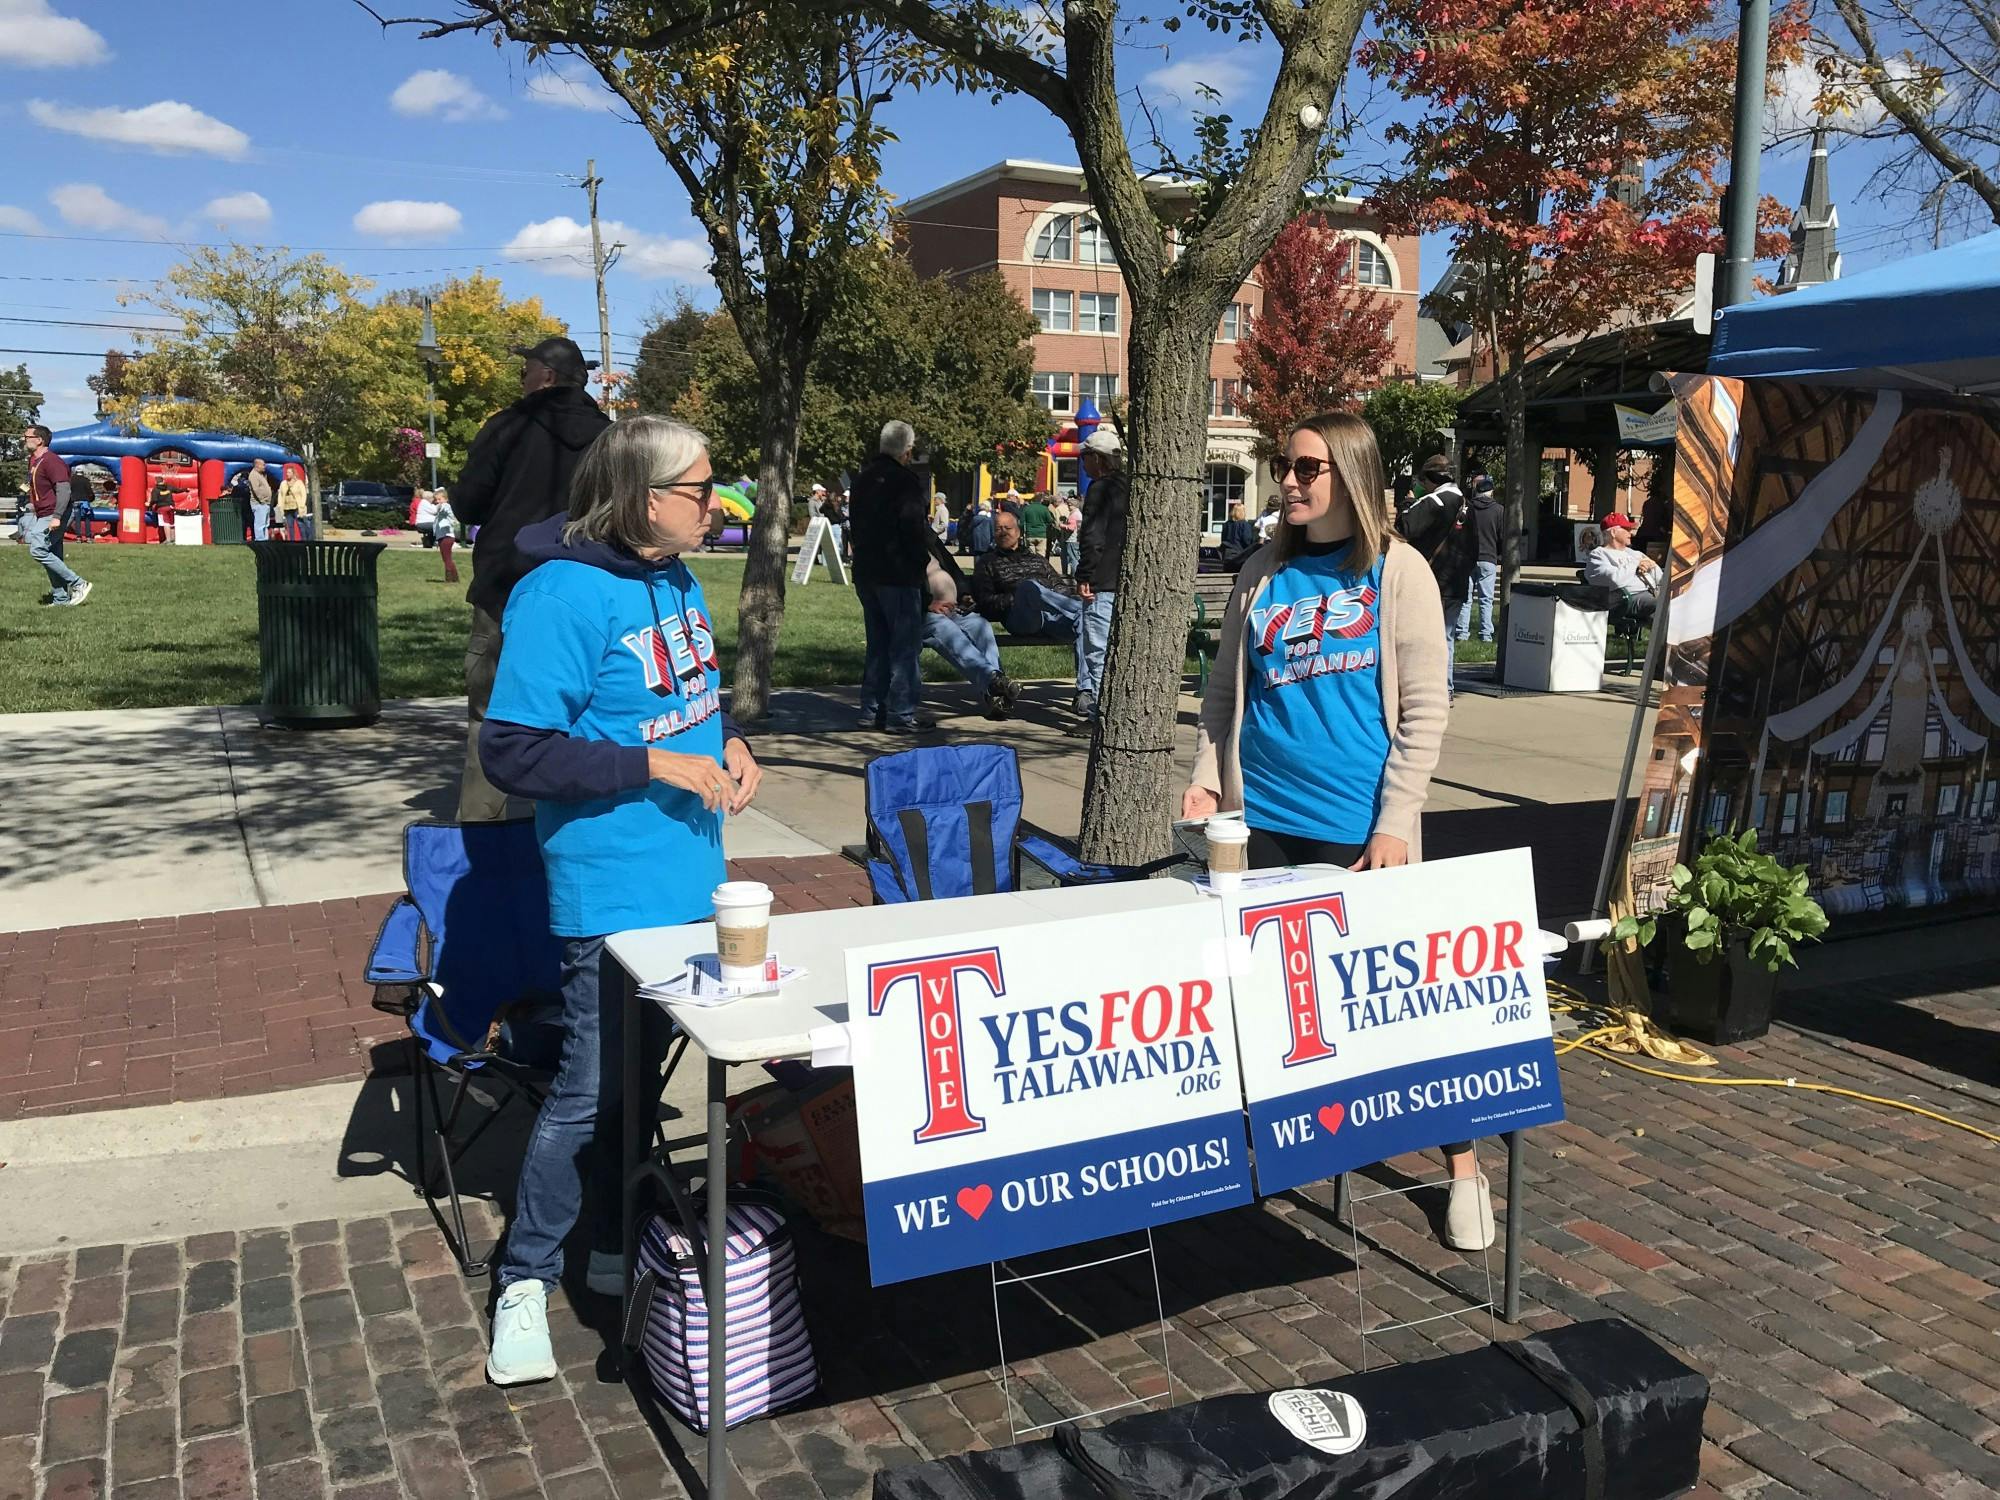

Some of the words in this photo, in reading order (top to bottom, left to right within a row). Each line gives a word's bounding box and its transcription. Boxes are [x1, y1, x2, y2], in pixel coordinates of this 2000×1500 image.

[621, 608, 717, 696] YES
[1251, 585, 1377, 655] YES
[1284, 639, 1320, 661] FOR
[682, 673, 708, 700] FOR
[1285, 919, 1314, 1037] VOTE
[1341, 971, 1532, 1032] TALAWANDA
[926, 977, 957, 1109] VOTE
[1491, 1001, 1533, 1026] .ORG
[994, 1036, 1221, 1105] TALAWANDA
[1176, 1070, 1222, 1097] .ORG
[1271, 1113, 1315, 1149] WE
[1350, 1090, 1404, 1127] OUR
[1408, 1061, 1542, 1112] SCHOOLS!
[893, 1195, 951, 1234] WE
[1001, 1173, 1074, 1212] OUR
[1080, 1136, 1231, 1195] SCHOOLS!
[1201, 1186, 1224, 1196] Talawanda
[1300, 1392, 1340, 1434] SHADE
